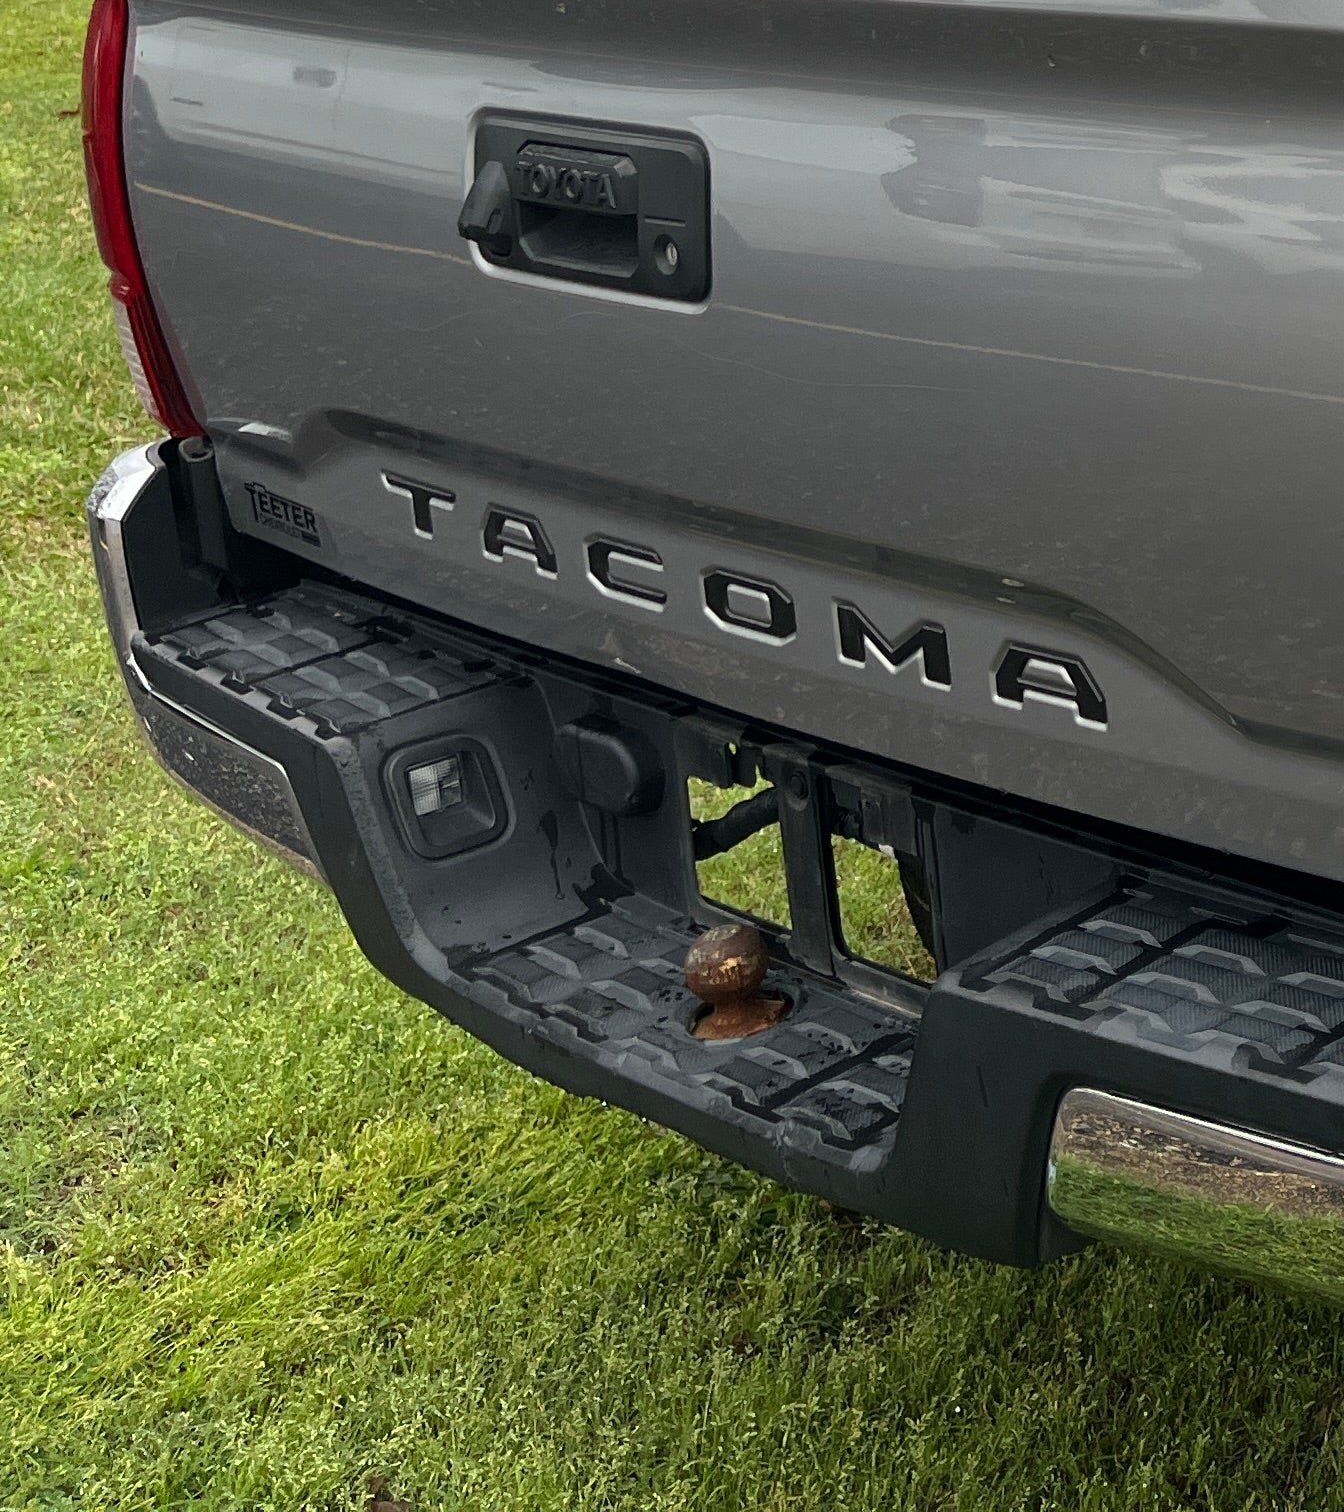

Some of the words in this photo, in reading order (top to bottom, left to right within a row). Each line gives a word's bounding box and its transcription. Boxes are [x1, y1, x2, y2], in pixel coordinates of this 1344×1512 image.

[515, 160, 617, 209] TOYOTA
[243, 481, 318, 535] TEETER
[381, 466, 1111, 734] TACOMA
